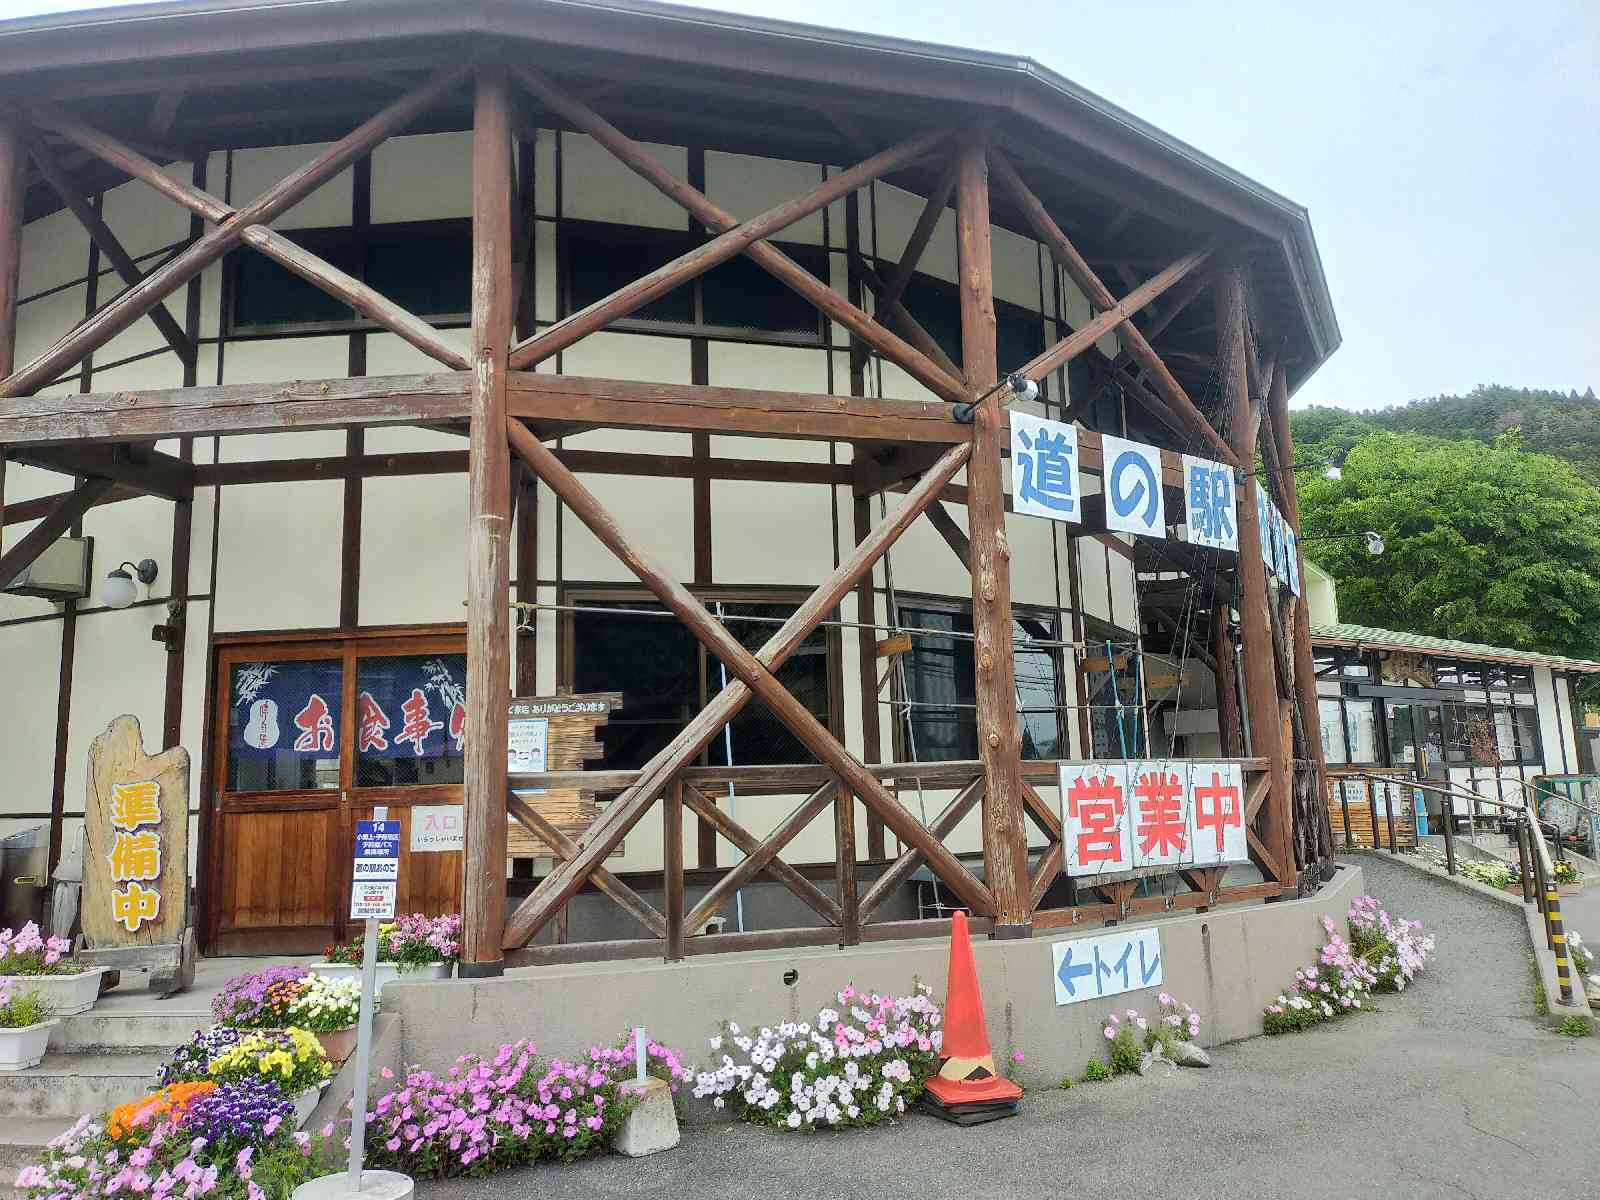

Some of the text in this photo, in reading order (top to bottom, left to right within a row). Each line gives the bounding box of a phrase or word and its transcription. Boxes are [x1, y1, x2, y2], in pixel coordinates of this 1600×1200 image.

[1017, 427, 1236, 541] 道の駅
[110, 780, 162, 932] 準備中
[372, 821, 385, 833] 14
[422, 814, 457, 832] 入口
[1067, 771, 1241, 867] 営業中
[1093, 939, 1160, 995] トイレ
